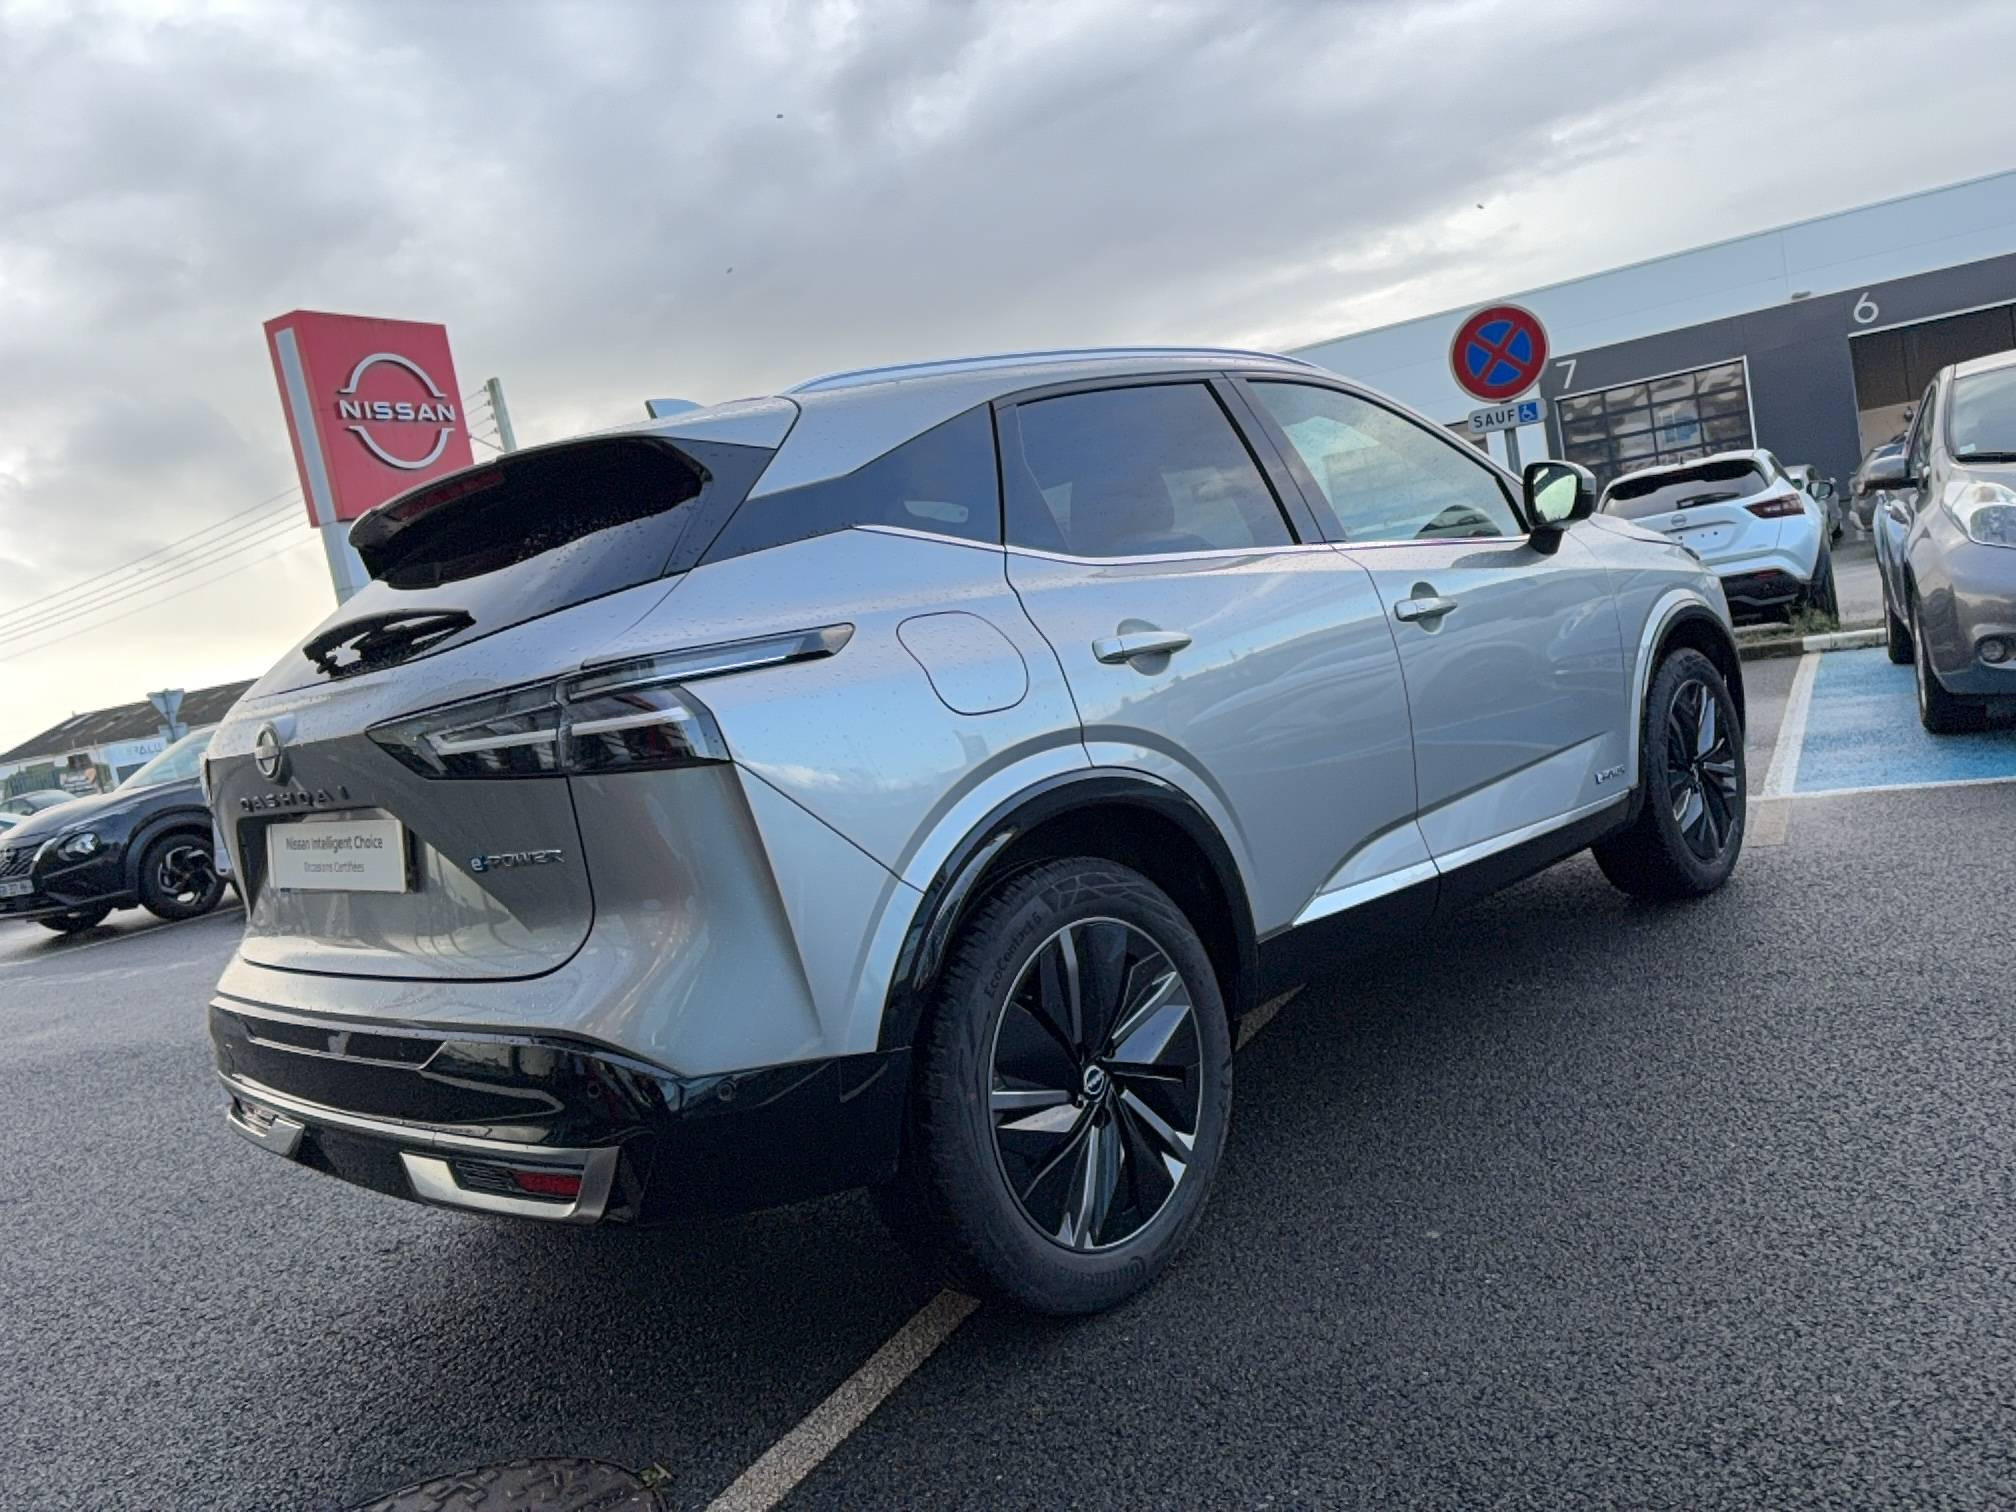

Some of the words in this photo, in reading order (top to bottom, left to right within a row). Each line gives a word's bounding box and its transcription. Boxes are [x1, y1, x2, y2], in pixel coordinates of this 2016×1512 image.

[1853, 291, 1879, 323] 6
[1555, 359, 1577, 389] 7
[339, 399, 456, 421] NISSAN
[1473, 408, 1515, 428] SAUF
[239, 785, 349, 813] QASHQAI
[285, 837, 311, 850] Nissan
[312, 835, 352, 854] Intelligent
[353, 833, 384, 850] Choice
